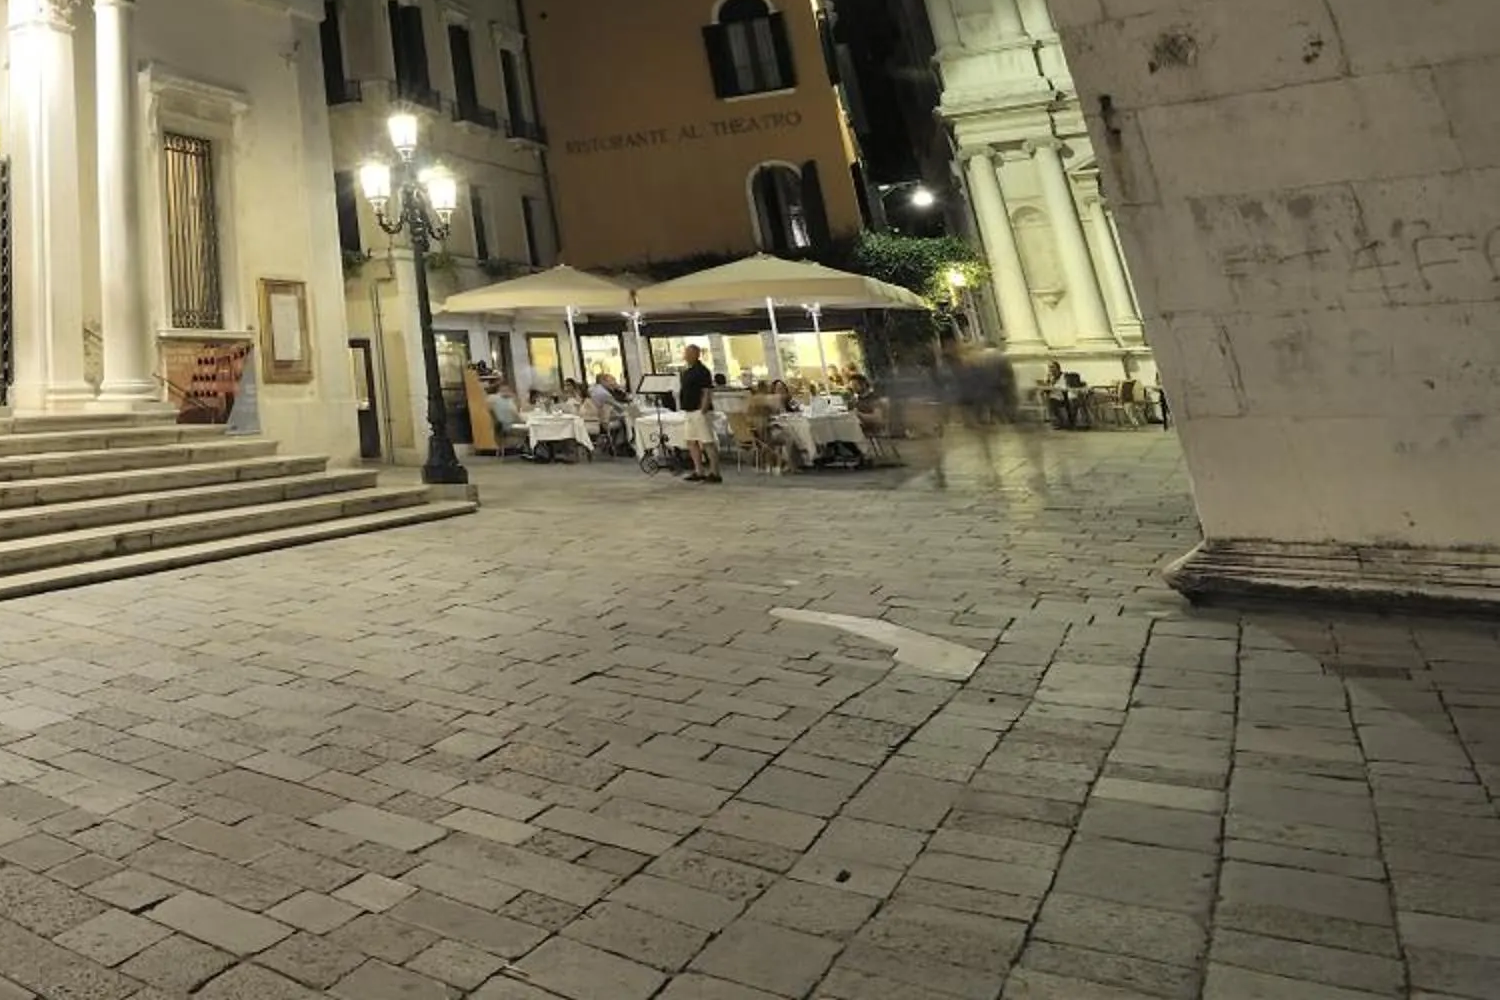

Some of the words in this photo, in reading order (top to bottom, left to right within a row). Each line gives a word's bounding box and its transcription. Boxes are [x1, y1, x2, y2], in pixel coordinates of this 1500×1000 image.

[565, 128, 668, 155] RISTORANTE
[678, 124, 703, 141] AL
[709, 109, 803, 137] THEATRO
